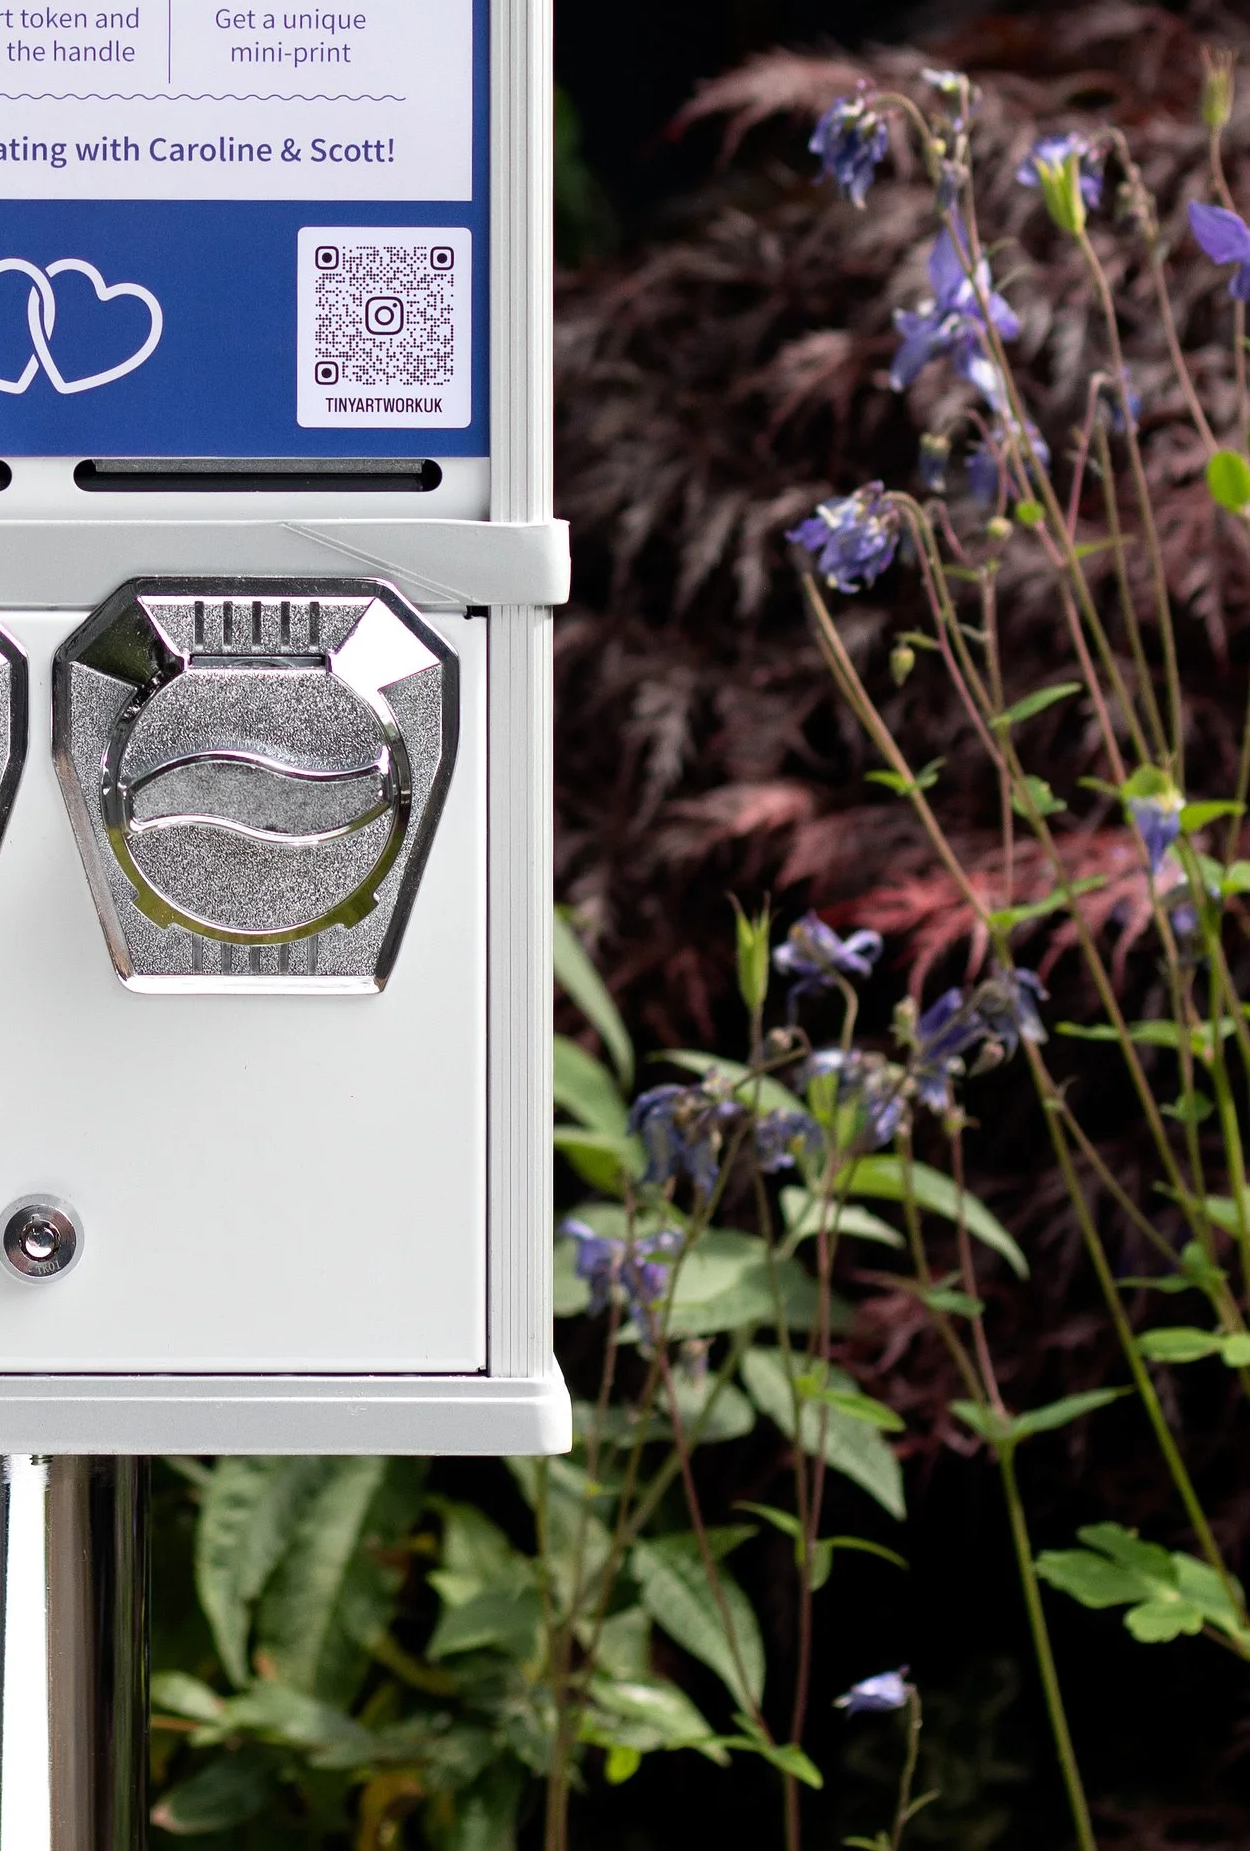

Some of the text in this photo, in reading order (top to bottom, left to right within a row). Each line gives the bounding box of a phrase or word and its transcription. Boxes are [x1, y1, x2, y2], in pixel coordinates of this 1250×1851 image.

[19, 6, 87, 29] token
[95, 6, 139, 29] and
[215, 8, 366, 35] Get a unique
[6, 39, 46, 62] the
[53, 39, 135, 62] handle
[231, 41, 351, 69] mini-print
[75, 135, 140, 162] with
[149, 136, 273, 163] Caroline
[280, 137, 302, 163] &
[310, 137, 395, 163] Scott!
[325, 397, 443, 413] TINYARTWORKUK
